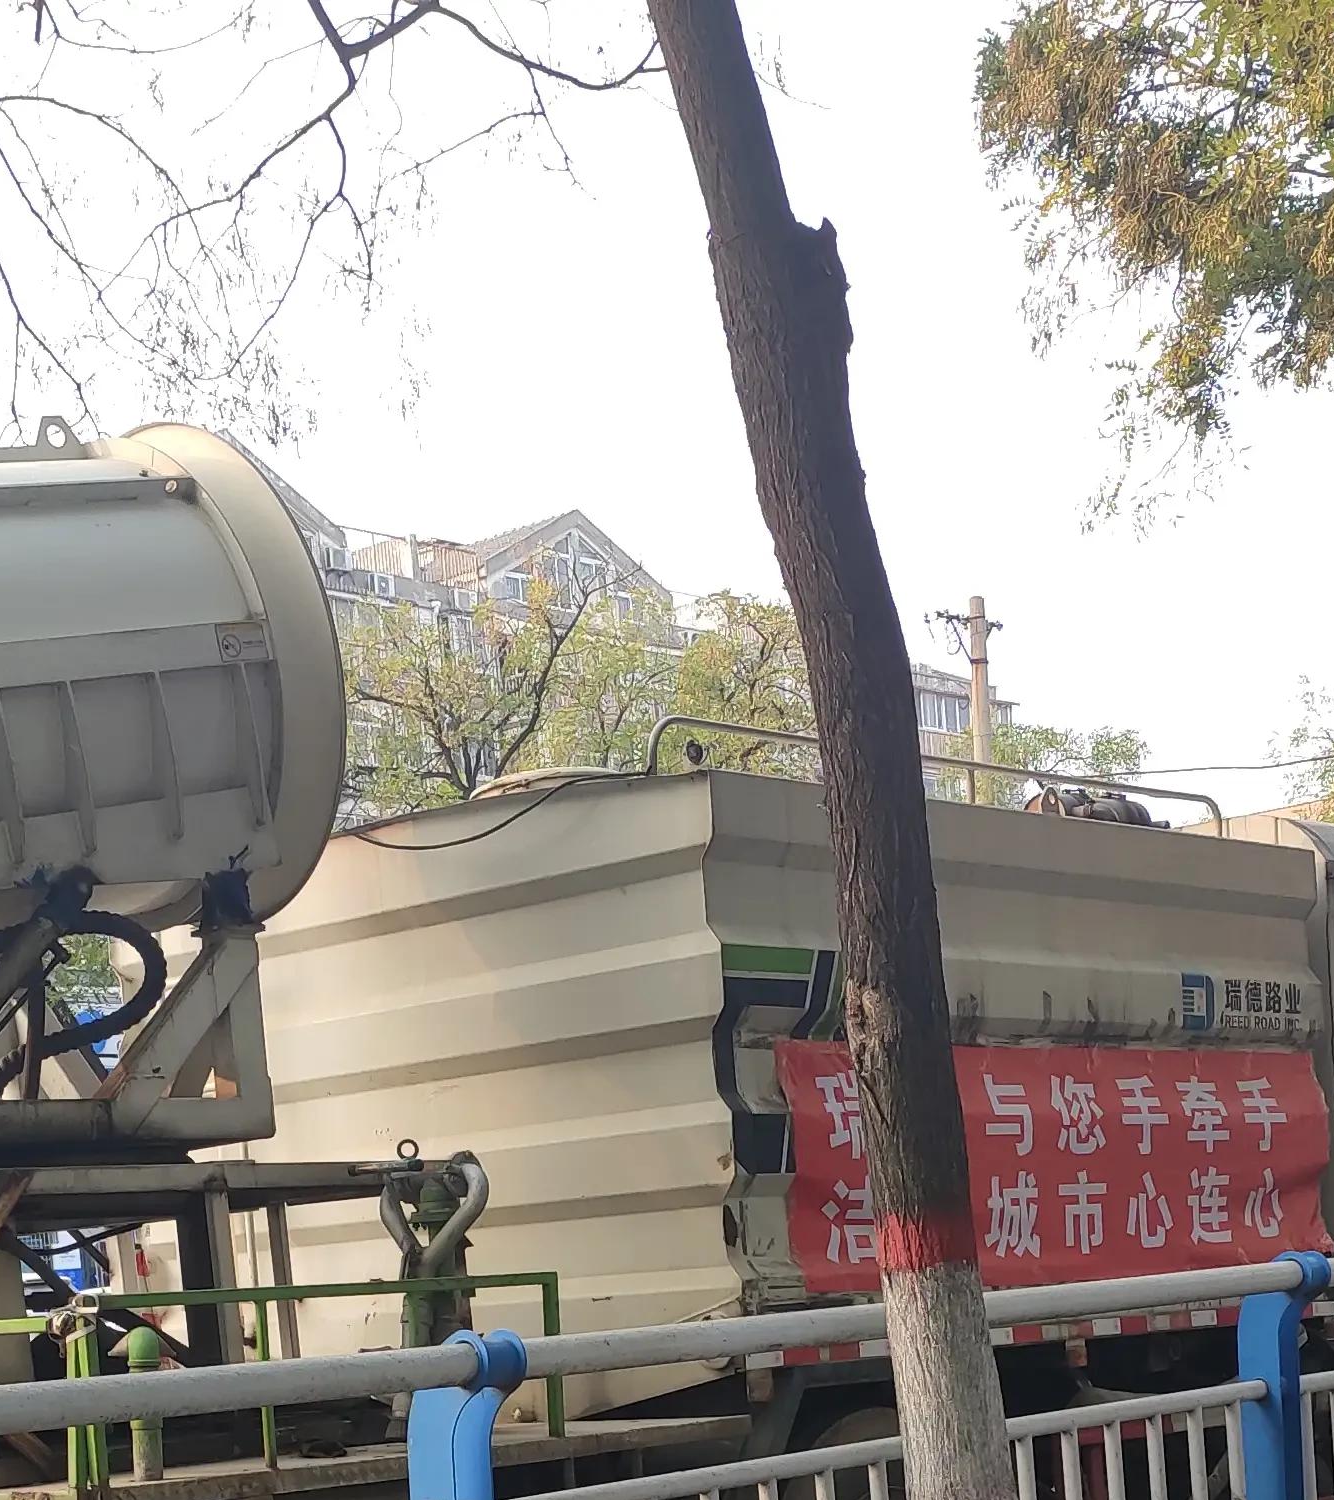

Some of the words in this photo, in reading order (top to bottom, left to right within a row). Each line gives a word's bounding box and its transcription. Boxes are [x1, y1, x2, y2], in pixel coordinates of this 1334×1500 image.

[1224, 979, 1301, 1014] 瑞德路业
[1225, 1014, 1250, 1029] REED
[1254, 1015, 1281, 1030] ROAD
[815, 1068, 1288, 1159] 瑞与您手牵手
[819, 1166, 1286, 1264] 洁城市心连心
